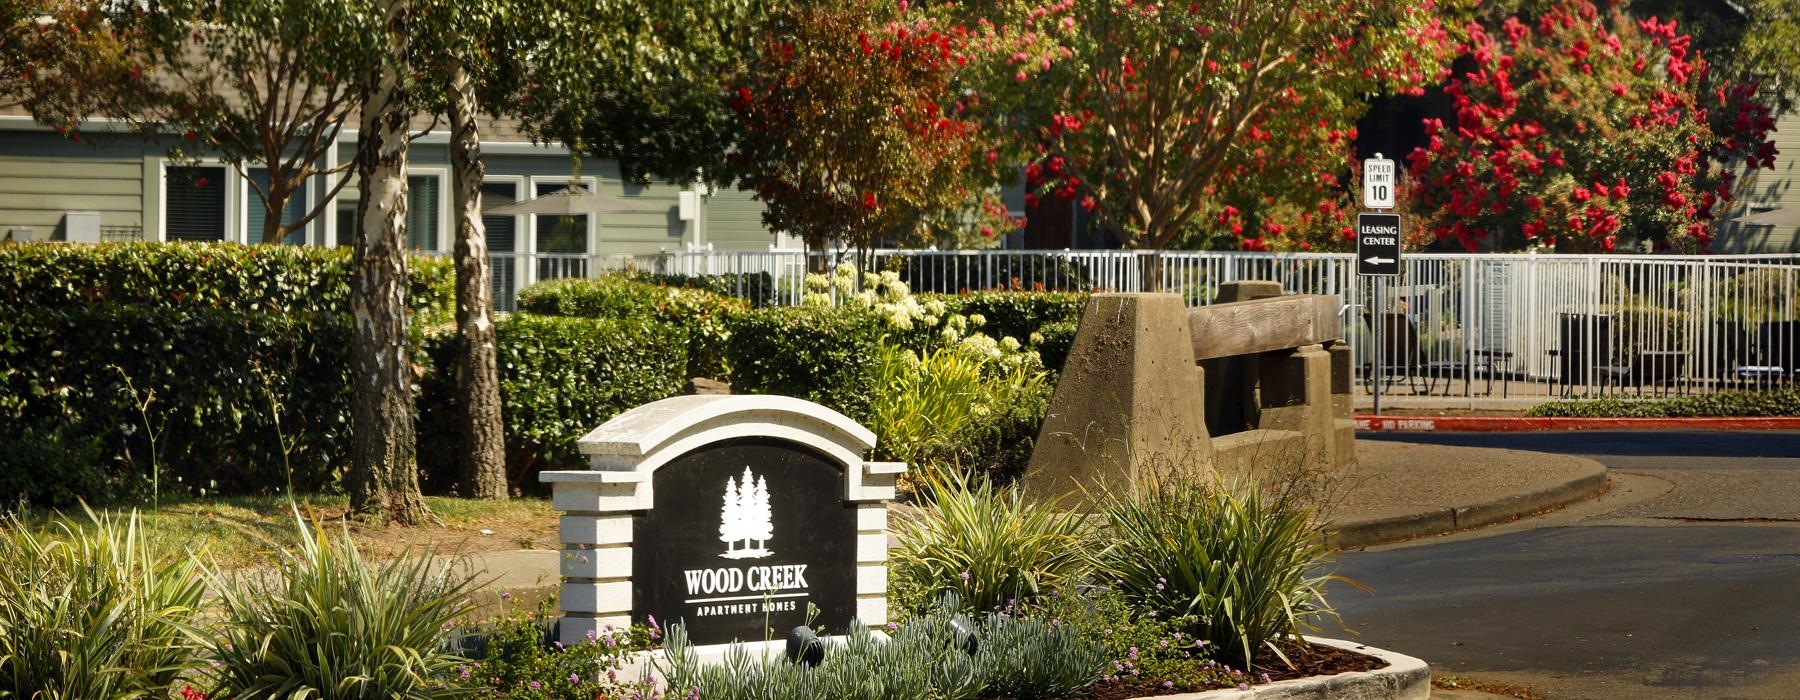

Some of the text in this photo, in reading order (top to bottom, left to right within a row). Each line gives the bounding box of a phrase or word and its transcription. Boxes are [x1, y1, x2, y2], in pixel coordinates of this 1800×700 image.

[1368, 164, 1391, 173] SPEED
[1369, 174, 1389, 182] LIMIT
[1372, 185, 1387, 201] 10
[1362, 226, 1397, 235] LEASING
[1363, 237, 1395, 246] CENTER
[1383, 420, 1395, 429] NO
[1398, 420, 1435, 430] PARKING
[684, 564, 809, 595] WOOD CREEK
[697, 601, 795, 616] APARTMENT HOMES
